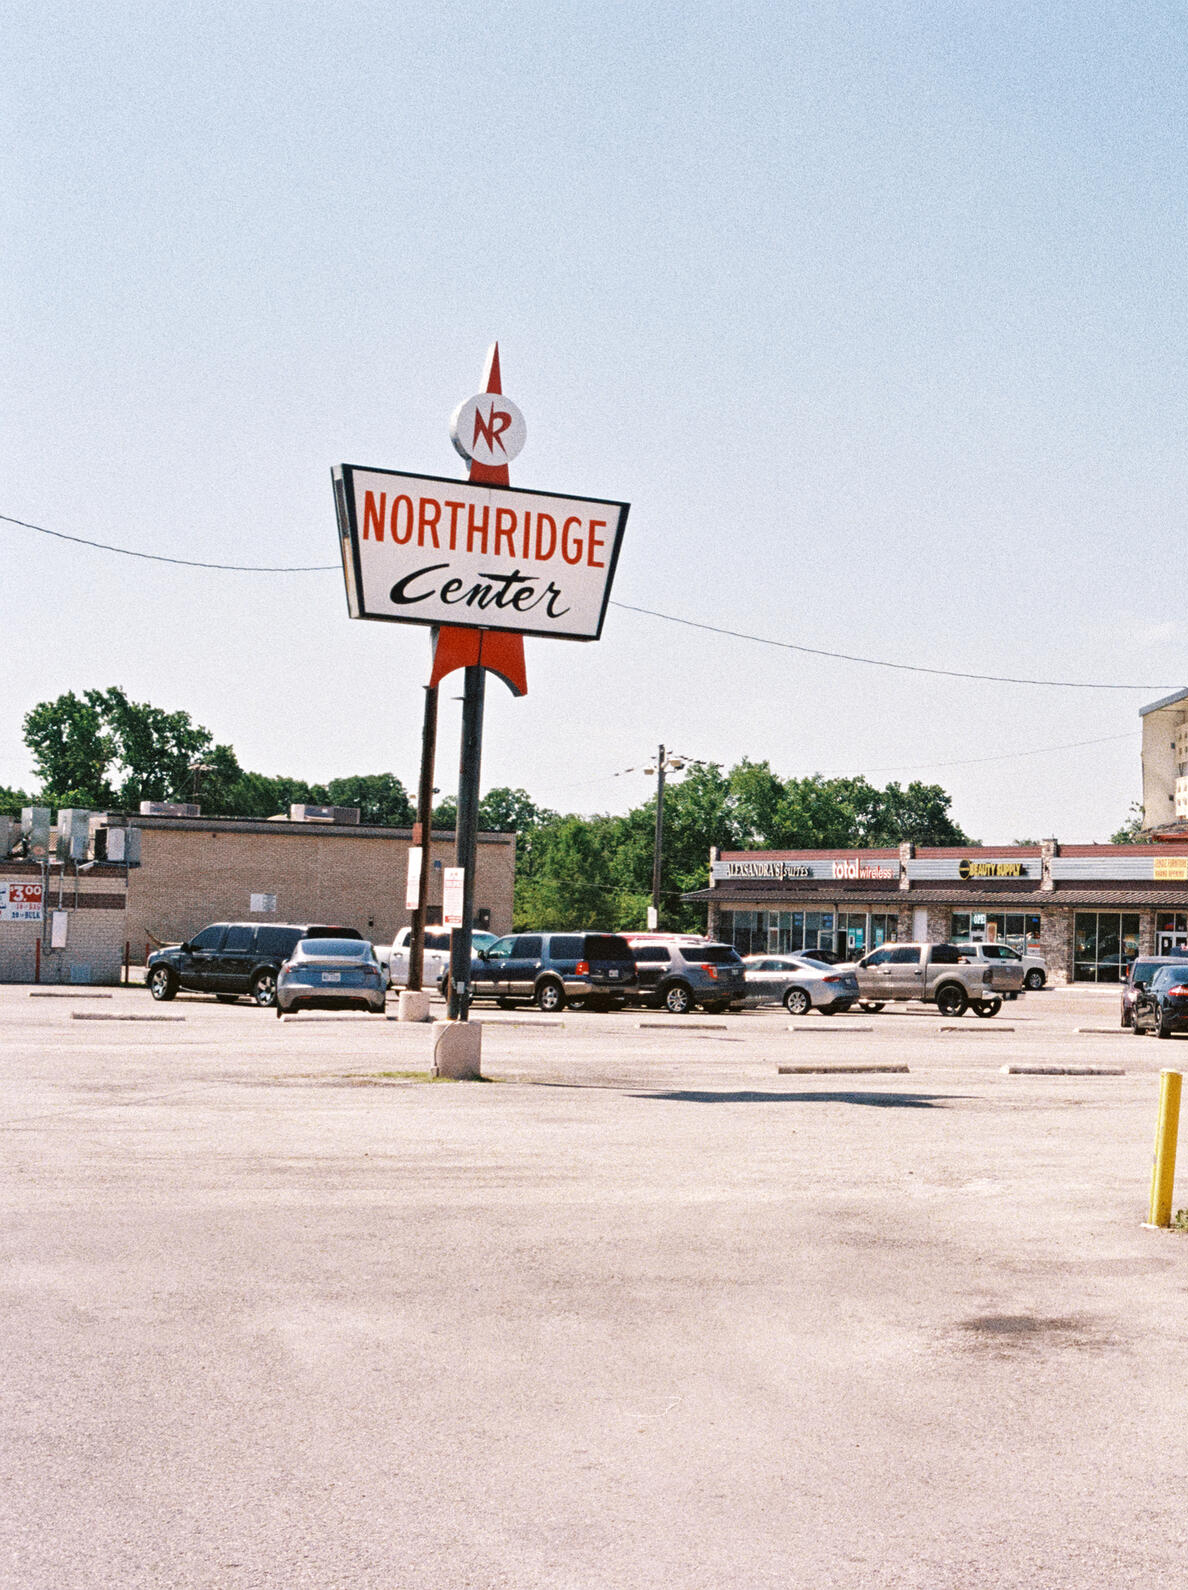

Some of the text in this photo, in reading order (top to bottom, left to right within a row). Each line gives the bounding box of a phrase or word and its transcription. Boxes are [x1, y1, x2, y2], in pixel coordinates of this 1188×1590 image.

[472, 401, 513, 458] NR
[362, 490, 607, 568] NORTHRIDGE
[389, 563, 571, 618] Center
[832, 857, 892, 880] total wireless
[970, 863, 1021, 876] BEAUTY SUPPLY
